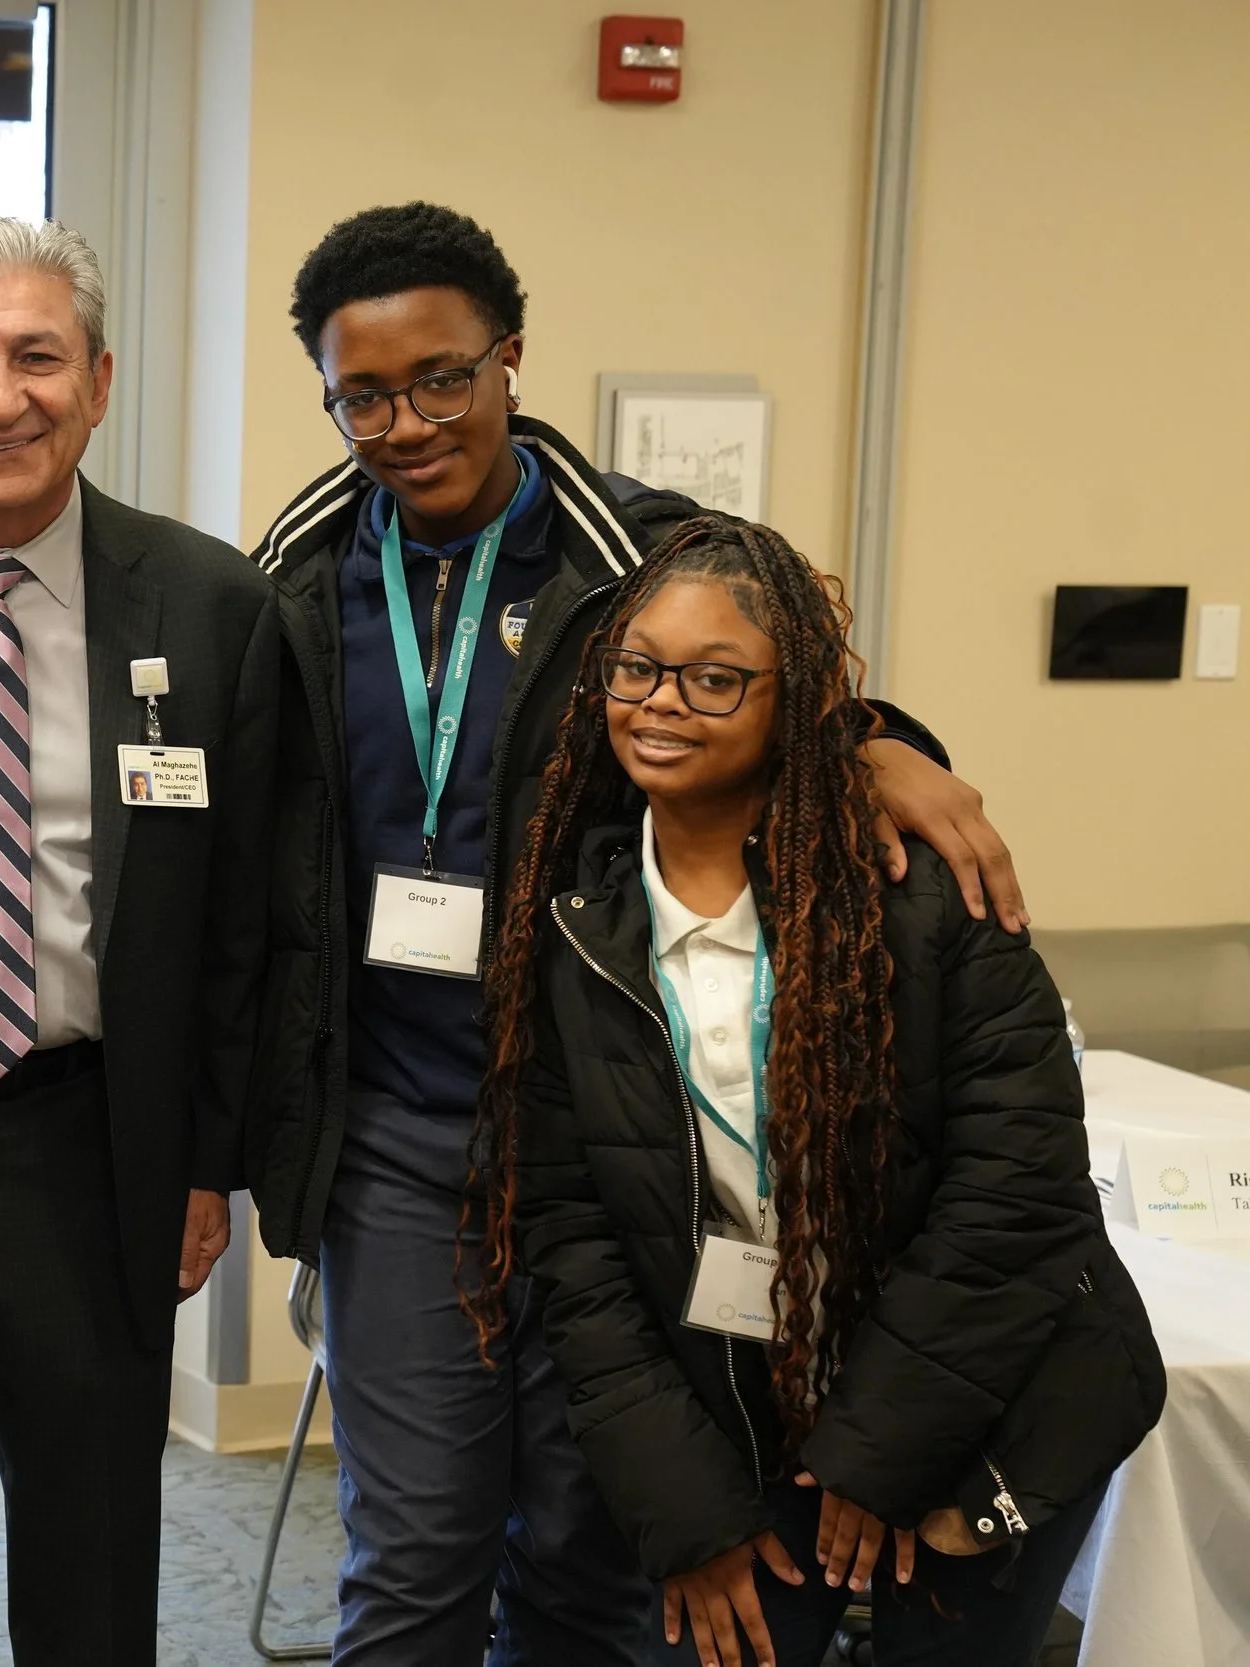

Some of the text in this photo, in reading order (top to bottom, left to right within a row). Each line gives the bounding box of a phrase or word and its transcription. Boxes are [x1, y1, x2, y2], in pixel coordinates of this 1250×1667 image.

[175, 774, 199, 782] FACHE
[408, 892, 447, 905] Group 2
[1229, 1172, 1250, 1187] Ri
[1231, 1197, 1250, 1210] Ta
[742, 1251, 778, 1269] Group
